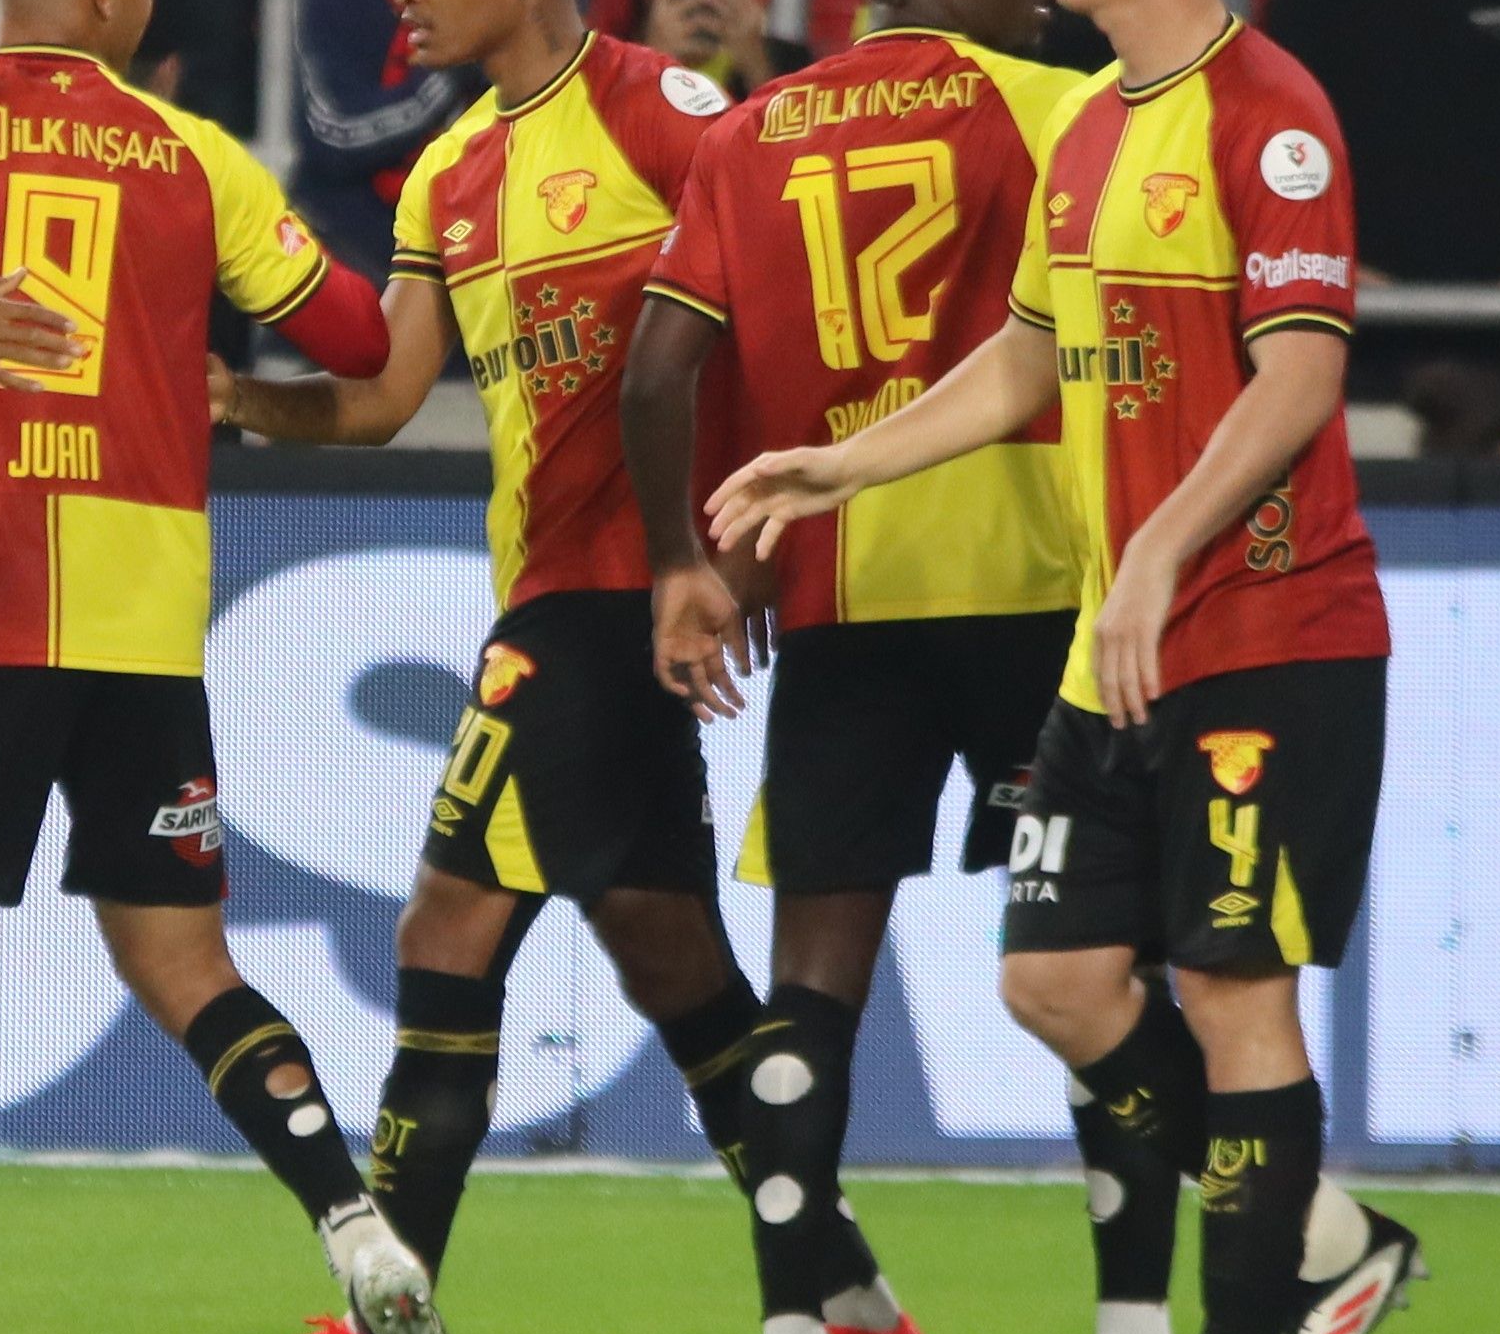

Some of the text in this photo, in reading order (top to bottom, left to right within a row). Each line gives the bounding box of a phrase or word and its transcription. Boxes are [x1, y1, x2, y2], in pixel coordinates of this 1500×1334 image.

[780, 138, 959, 371] 12
[470, 314, 583, 391] euroil
[7, 421, 101, 482] JUAN
[1208, 797, 1261, 888] 4
